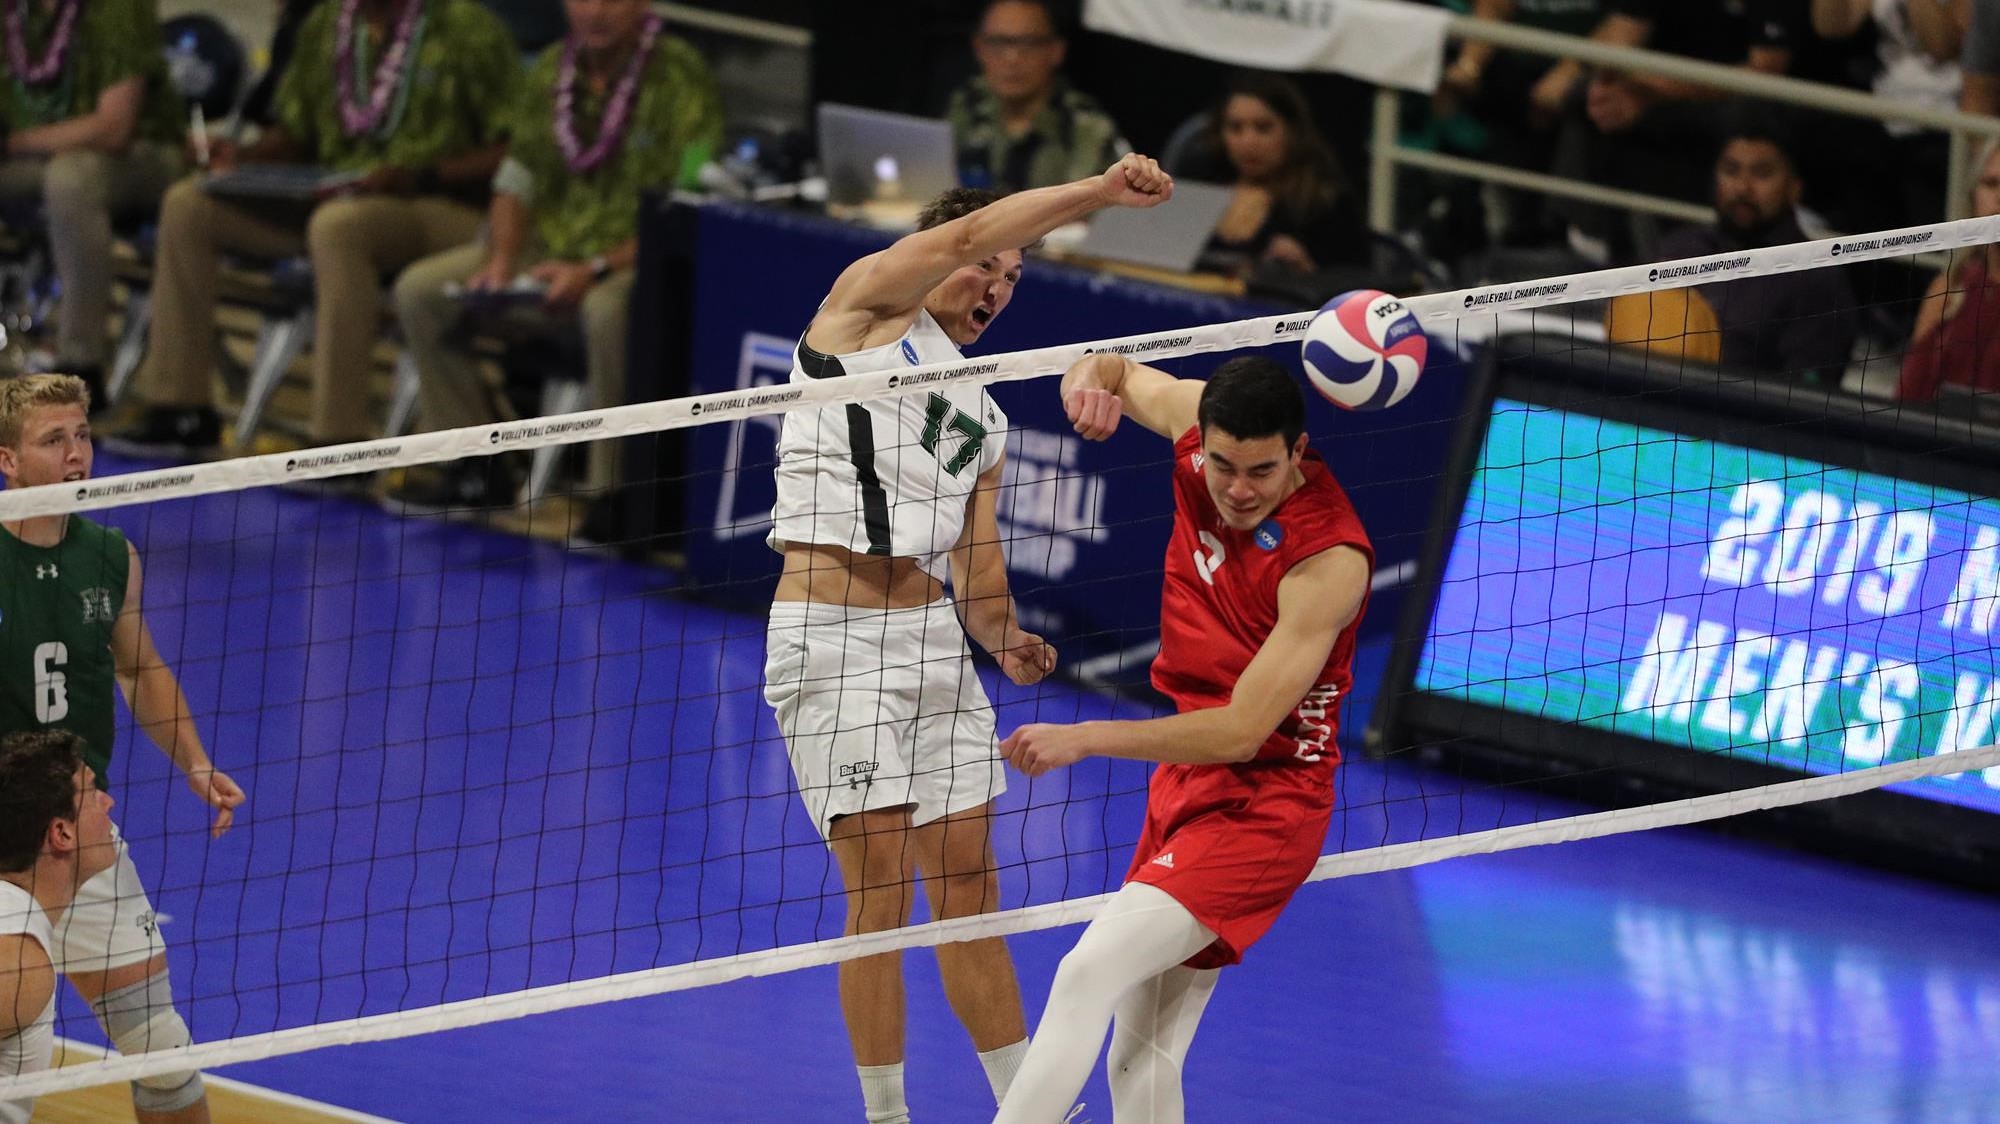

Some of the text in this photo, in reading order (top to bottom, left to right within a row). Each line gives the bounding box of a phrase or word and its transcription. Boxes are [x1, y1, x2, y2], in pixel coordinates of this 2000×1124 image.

[1842, 231, 1933, 254] VOLLEYBALL CHAMPIONSHIP
[1659, 257, 1751, 279] VOLLEYBALL CHAMPIONSHIP
[1473, 282, 1568, 305] VOLLEYBALL CHAMPIONSHIP
[1135, 336, 1193, 353] CHAMPIONSHIP
[900, 371, 942, 386] VOLLEYBALL
[702, 390, 803, 413] VOLLEYBALL CHAMPIONSHIP
[501, 417, 604, 441] VOLLEYBALL CHAMPIONSHIP
[920, 391, 987, 480] 17
[1700, 477, 1936, 617] 2019
[34, 641, 70, 724] 6
[1621, 610, 1922, 766] MEN'S
